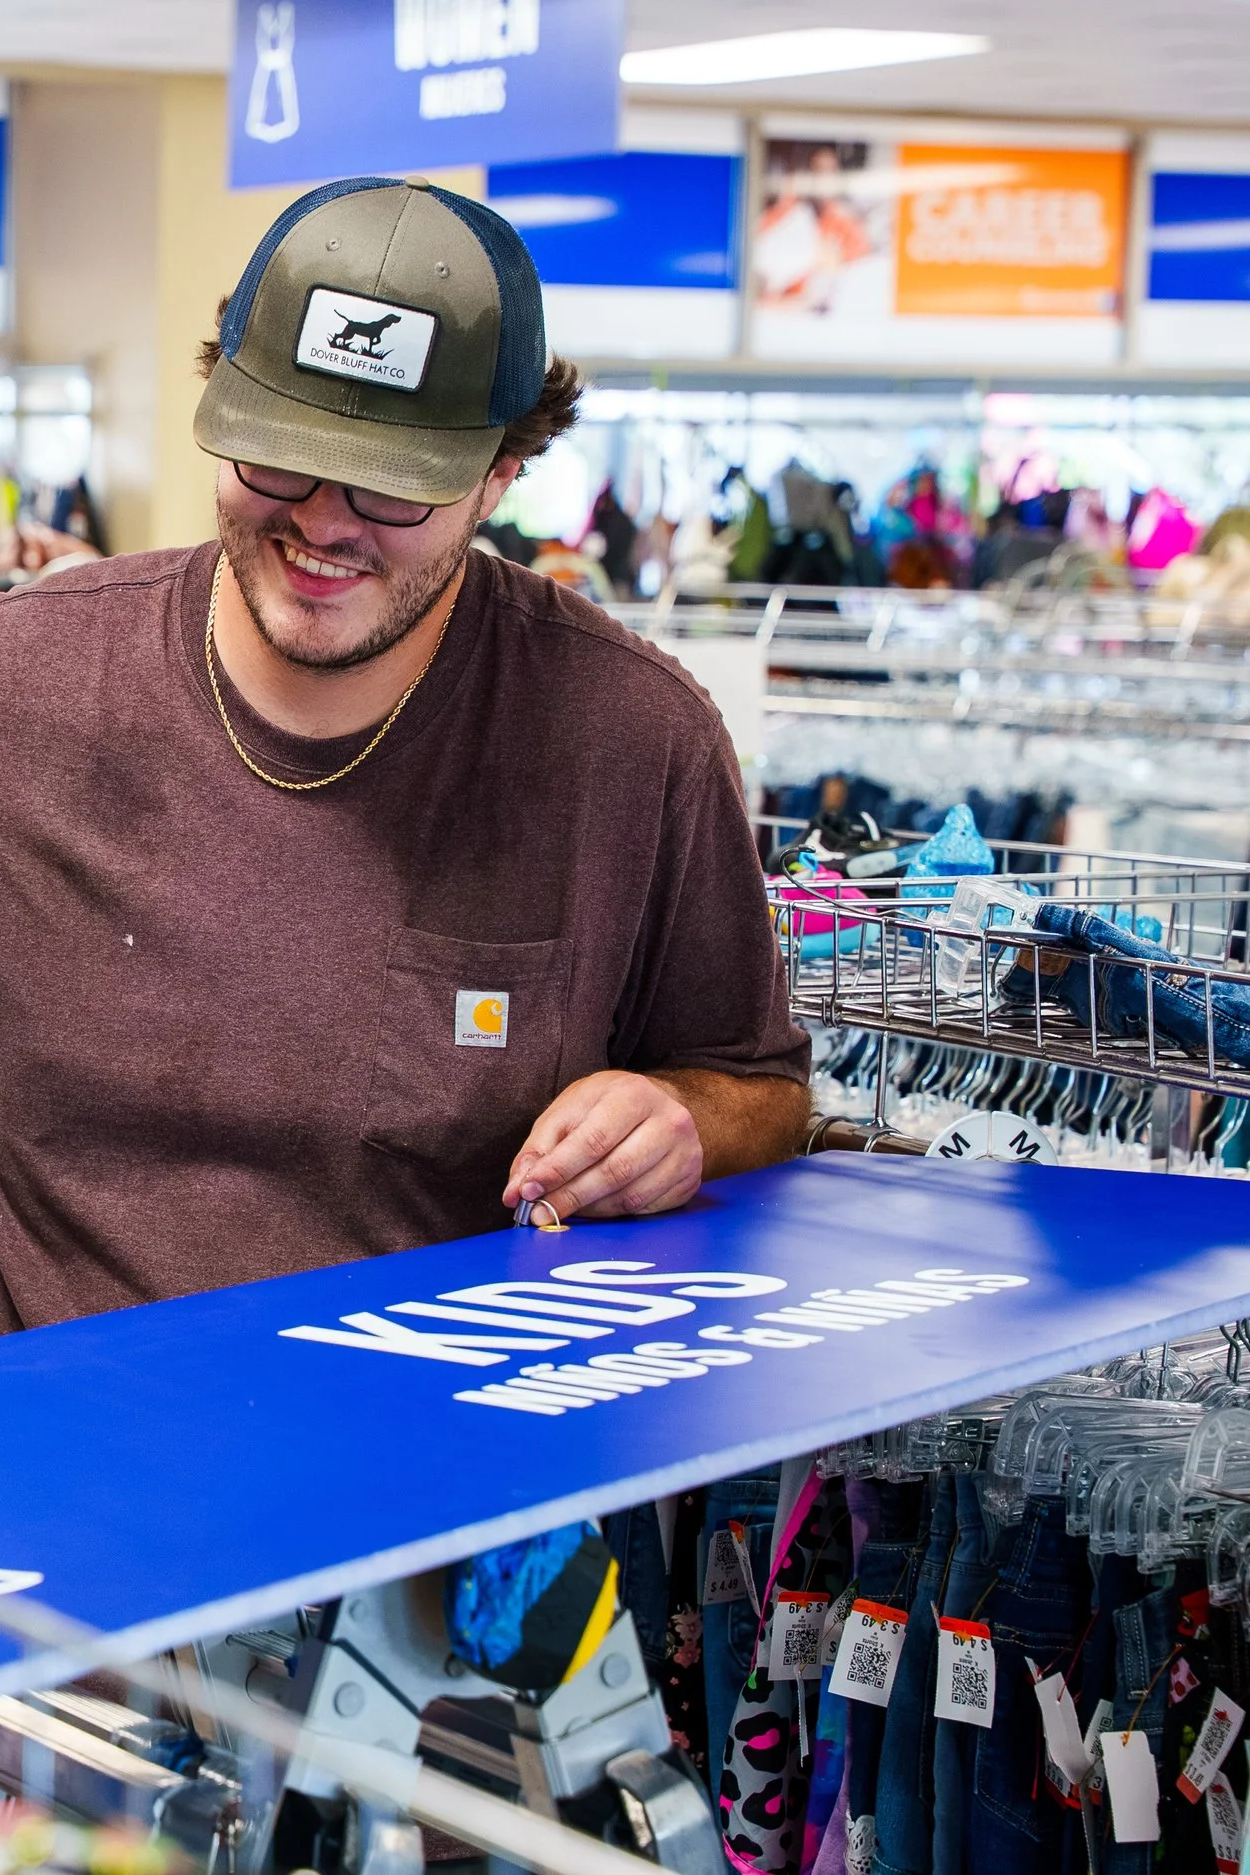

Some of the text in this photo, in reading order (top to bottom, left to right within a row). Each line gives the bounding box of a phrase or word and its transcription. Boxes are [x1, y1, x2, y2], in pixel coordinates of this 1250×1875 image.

[310, 347, 406, 380] DOVER BLUFF HAT CO.
[461, 1032, 502, 1041] carhartt
[938, 1131, 972, 1158] M
[1008, 1129, 1041, 1158] M
[278, 1260, 788, 1366] KIDS
[453, 1268, 1031, 1416] NIÑOS & NIÑAS
[719, 1578, 739, 1592] 4.49
[788, 1602, 813, 1614] 349
[861, 1614, 889, 1632] 349
[952, 1633, 977, 1649] 449
